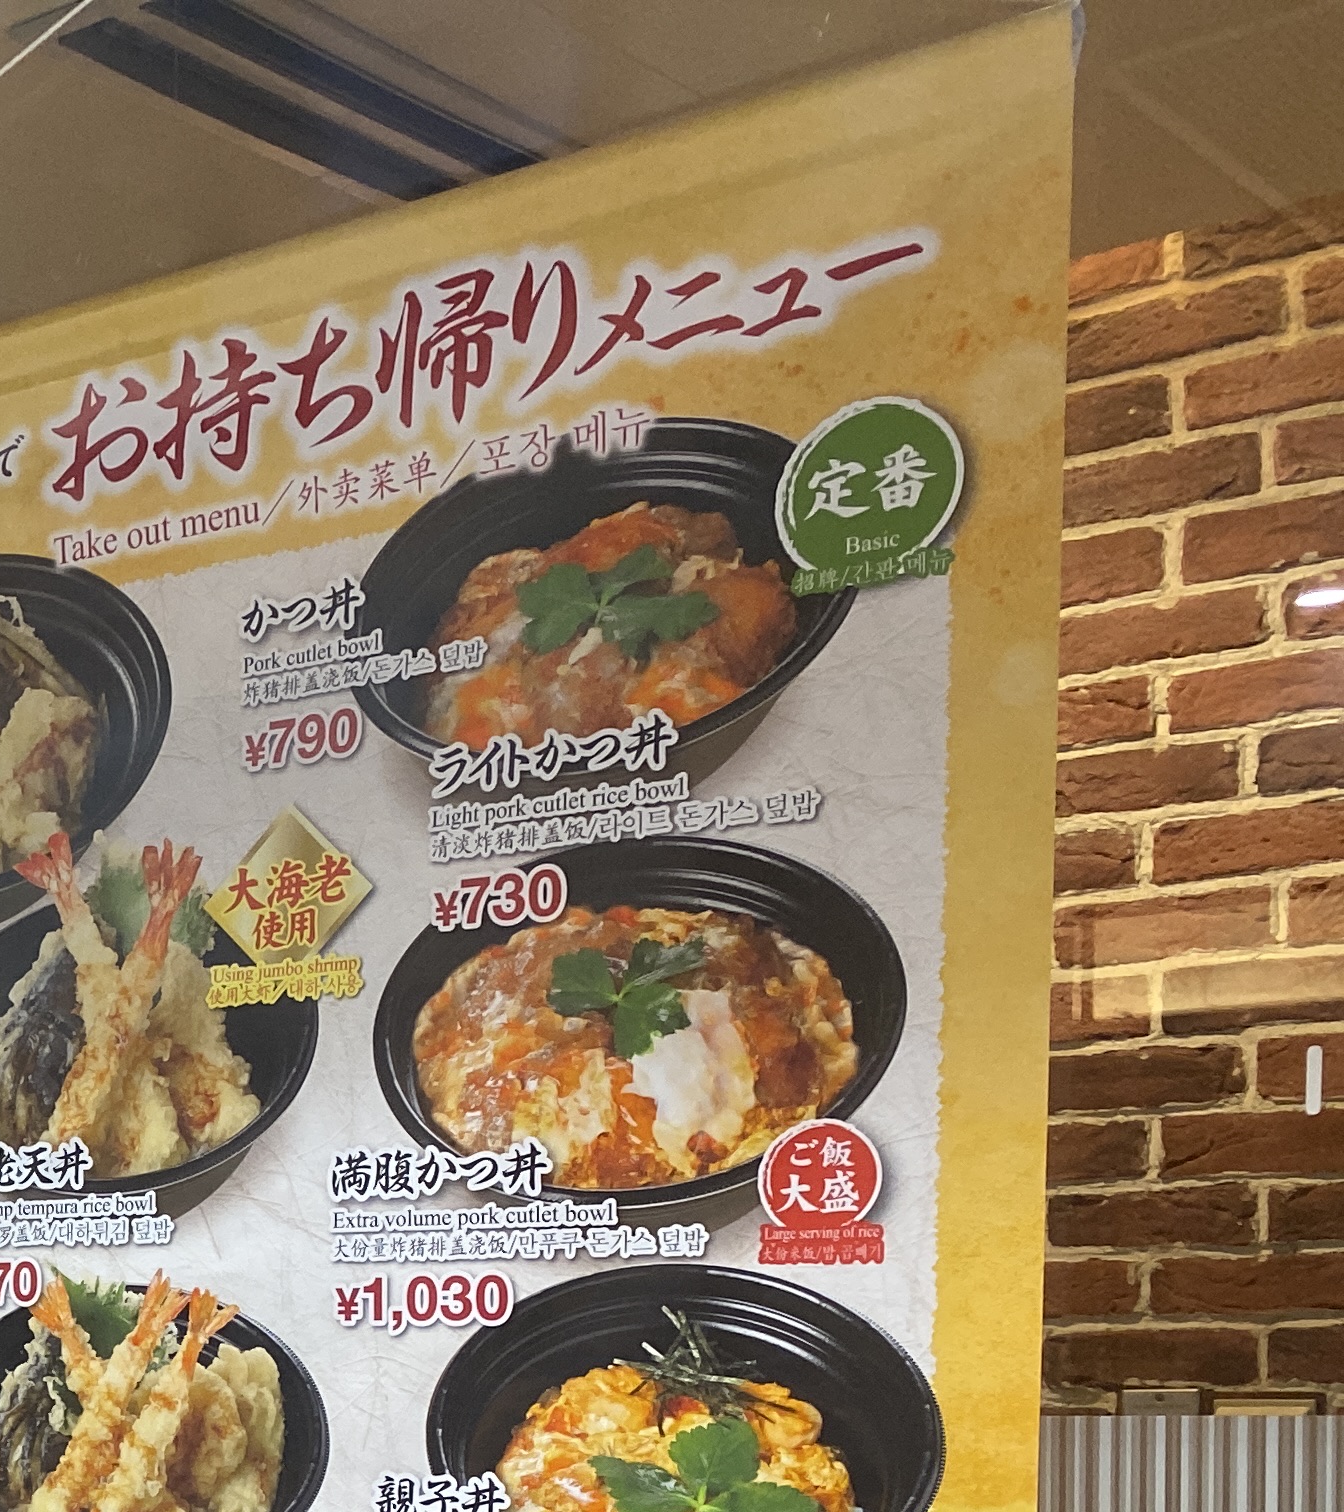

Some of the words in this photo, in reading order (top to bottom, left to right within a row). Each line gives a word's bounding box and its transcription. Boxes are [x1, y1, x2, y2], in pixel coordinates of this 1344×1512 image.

[52, 242, 925, 500] お持ち帰りメニュー
[575, 407, 652, 453] 메뉴
[804, 444, 937, 521] 定番
[54, 528, 117, 568] Take
[127, 518, 171, 546] out
[846, 530, 900, 555] Basic
[242, 578, 360, 638] かつ丼
[244, 653, 281, 674] Pork
[286, 644, 331, 666] cutlet
[337, 632, 380, 657] bowl
[245, 708, 358, 767] ¥790
[433, 717, 672, 792] ライトかつ丼
[431, 807, 481, 832] Light
[485, 798, 527, 826] pork
[532, 791, 586, 815] cutlet
[592, 787, 628, 808] rice
[635, 778, 686, 802] bowl
[224, 854, 351, 914] 大海老
[434, 868, 563, 928] ¥730
[252, 907, 316, 950] 使用
[213, 966, 259, 984] Using
[259, 962, 303, 982] jumbo
[308, 957, 358, 974] shrimp
[332, 1142, 547, 1195] 満腹かつ丼
[790, 1136, 855, 1168] ご飯
[18, 1202, 78, 1220] tempura
[83, 1199, 111, 1213] rice
[115, 1196, 154, 1212] bowl
[776, 1170, 860, 1213] 大盛
[336, 1274, 510, 1331] ¥1,030
